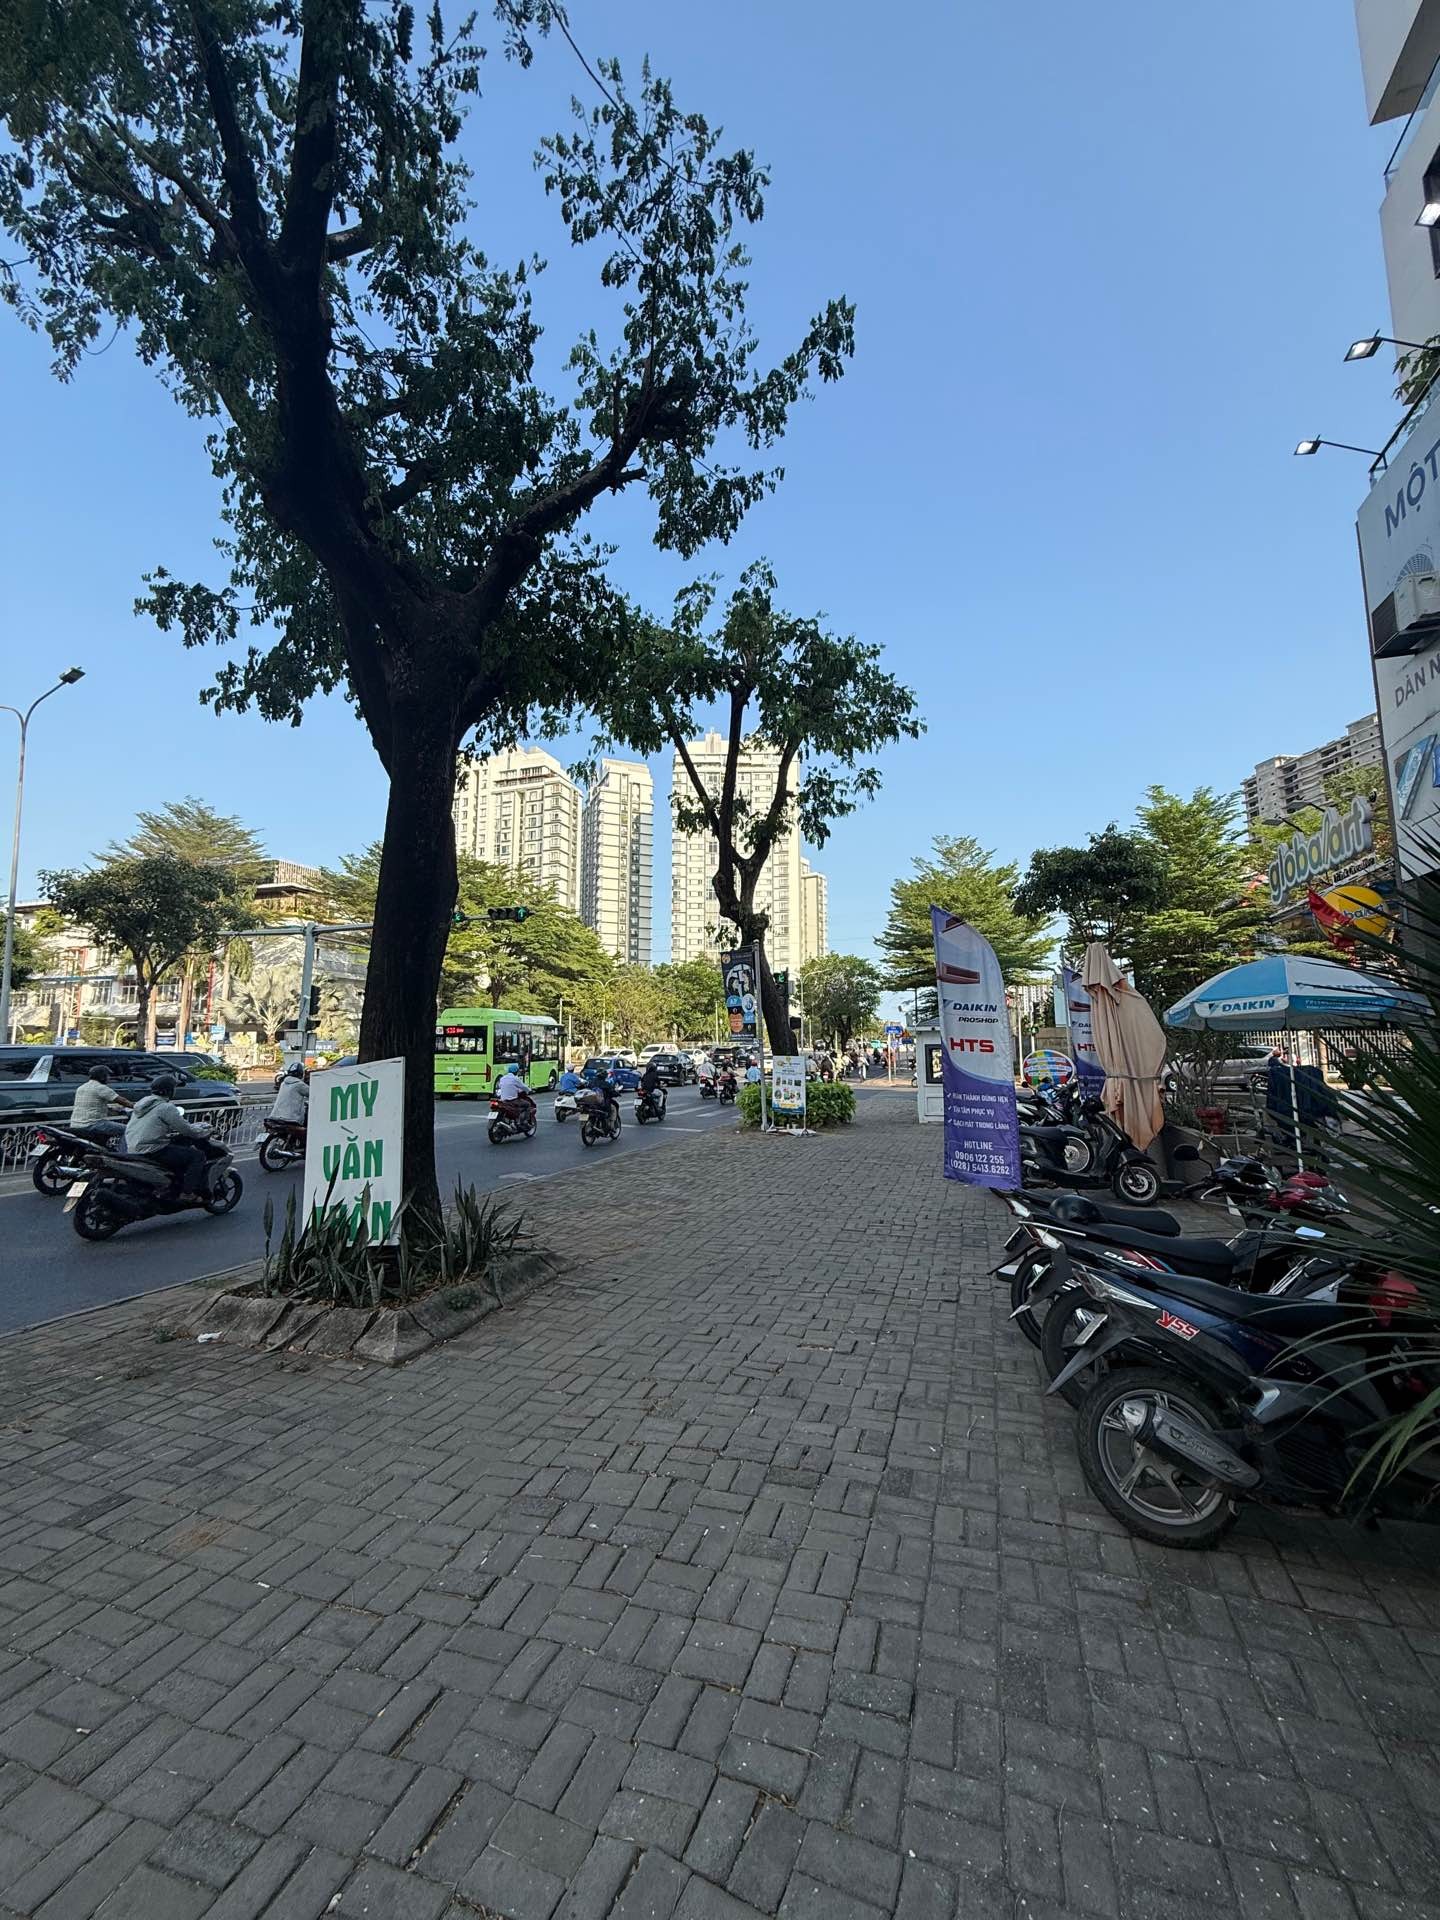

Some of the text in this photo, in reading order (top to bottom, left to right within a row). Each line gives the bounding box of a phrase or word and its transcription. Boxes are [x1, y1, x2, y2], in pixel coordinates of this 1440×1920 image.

[1394, 667, 1426, 708] DÀN
[953, 1002, 998, 1013] DAIKIN
[1221, 999, 1276, 1013] DAIKIN
[958, 1016, 999, 1024] PROSHOP
[949, 1037, 995, 1053] HTS
[964, 1140, 994, 1150] HOTLINE
[954, 1150, 1005, 1165] 0906 122 255
[950, 1158, 970, 1172] (028)
[1158, 1311, 1199, 1337] YSS
